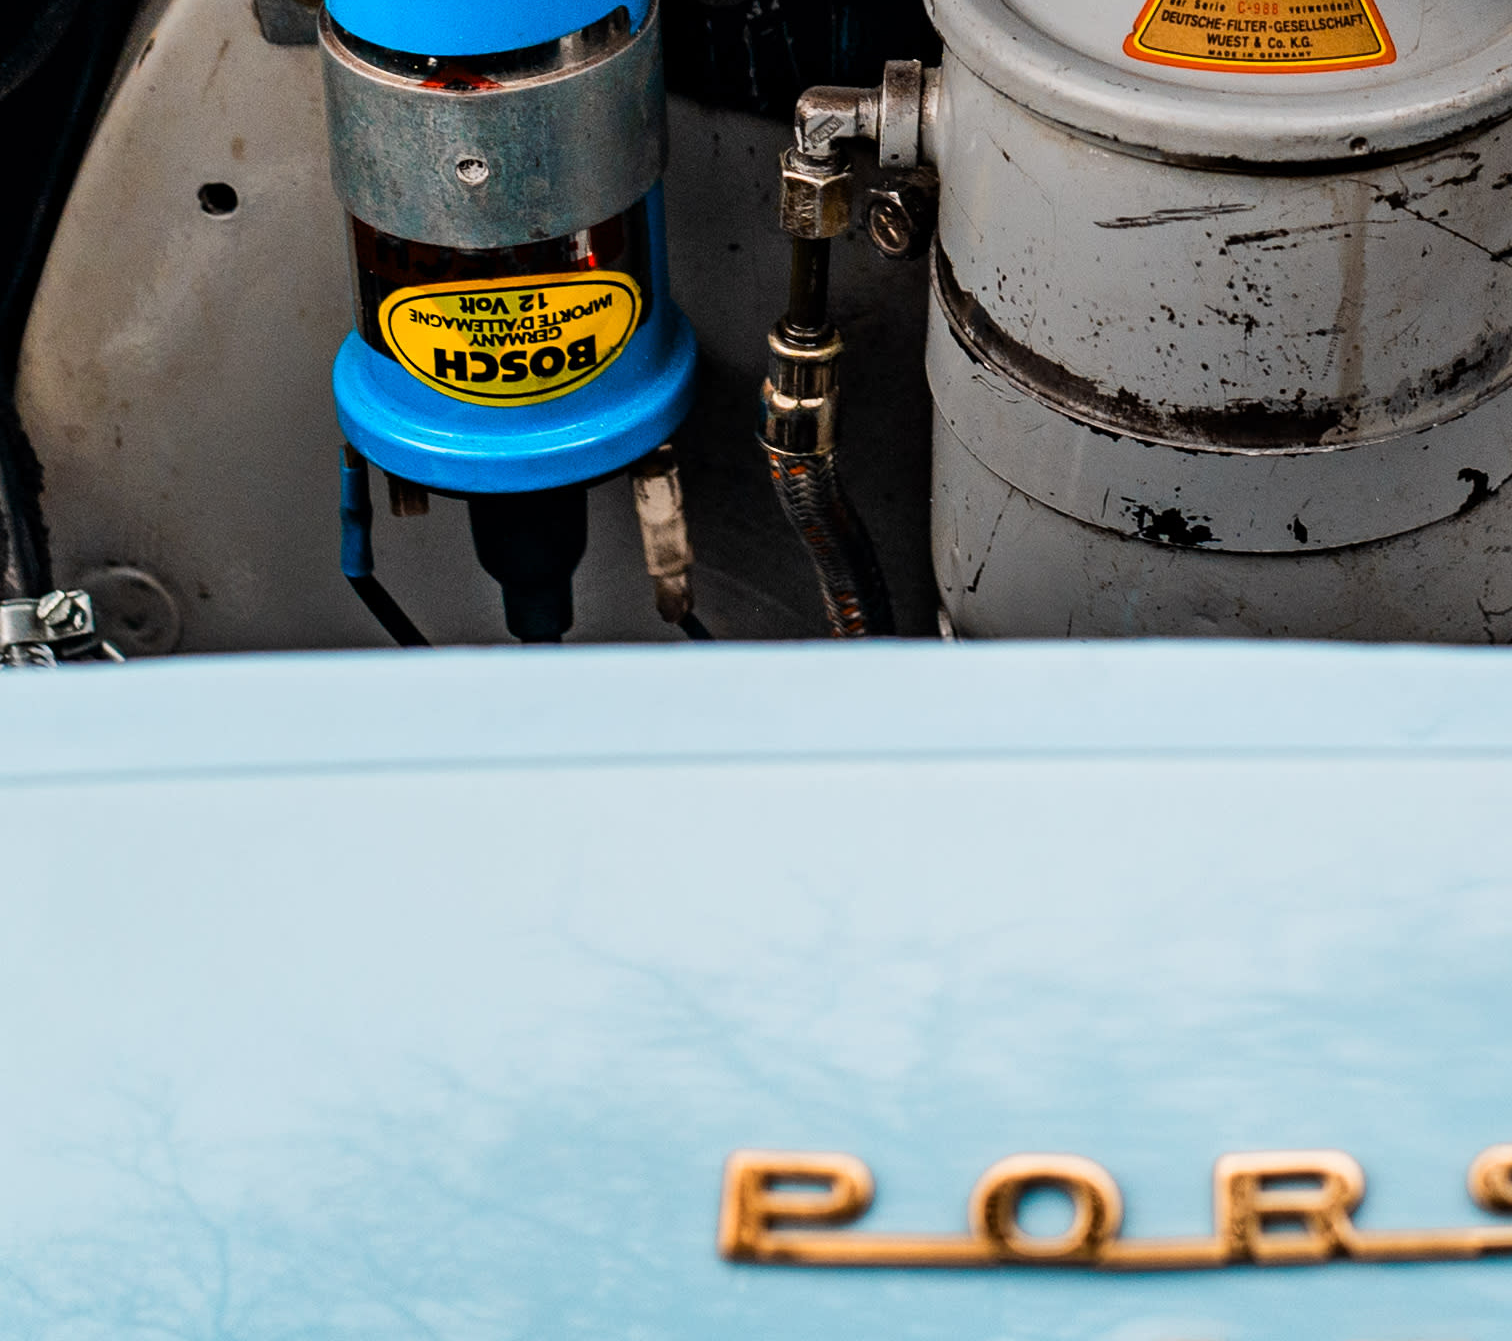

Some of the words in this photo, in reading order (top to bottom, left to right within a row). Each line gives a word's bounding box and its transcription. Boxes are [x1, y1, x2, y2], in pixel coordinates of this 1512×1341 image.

[1194, 0, 1226, 12] Serie
[1238, 0, 1279, 15] C-988
[1206, 32, 1249, 49] WUEST
[1254, 36, 1262, 49] &
[1267, 35, 1287, 50] Co.
[1290, 35, 1314, 49] K.G.
[459, 296, 510, 315] Volt
[518, 292, 549, 312] 12
[538, 293, 613, 329] IMPORTE
[409, 308, 534, 333] D'ALLEMAGNE
[469, 326, 562, 348] GERMANY
[433, 334, 597, 383] BOSCH
